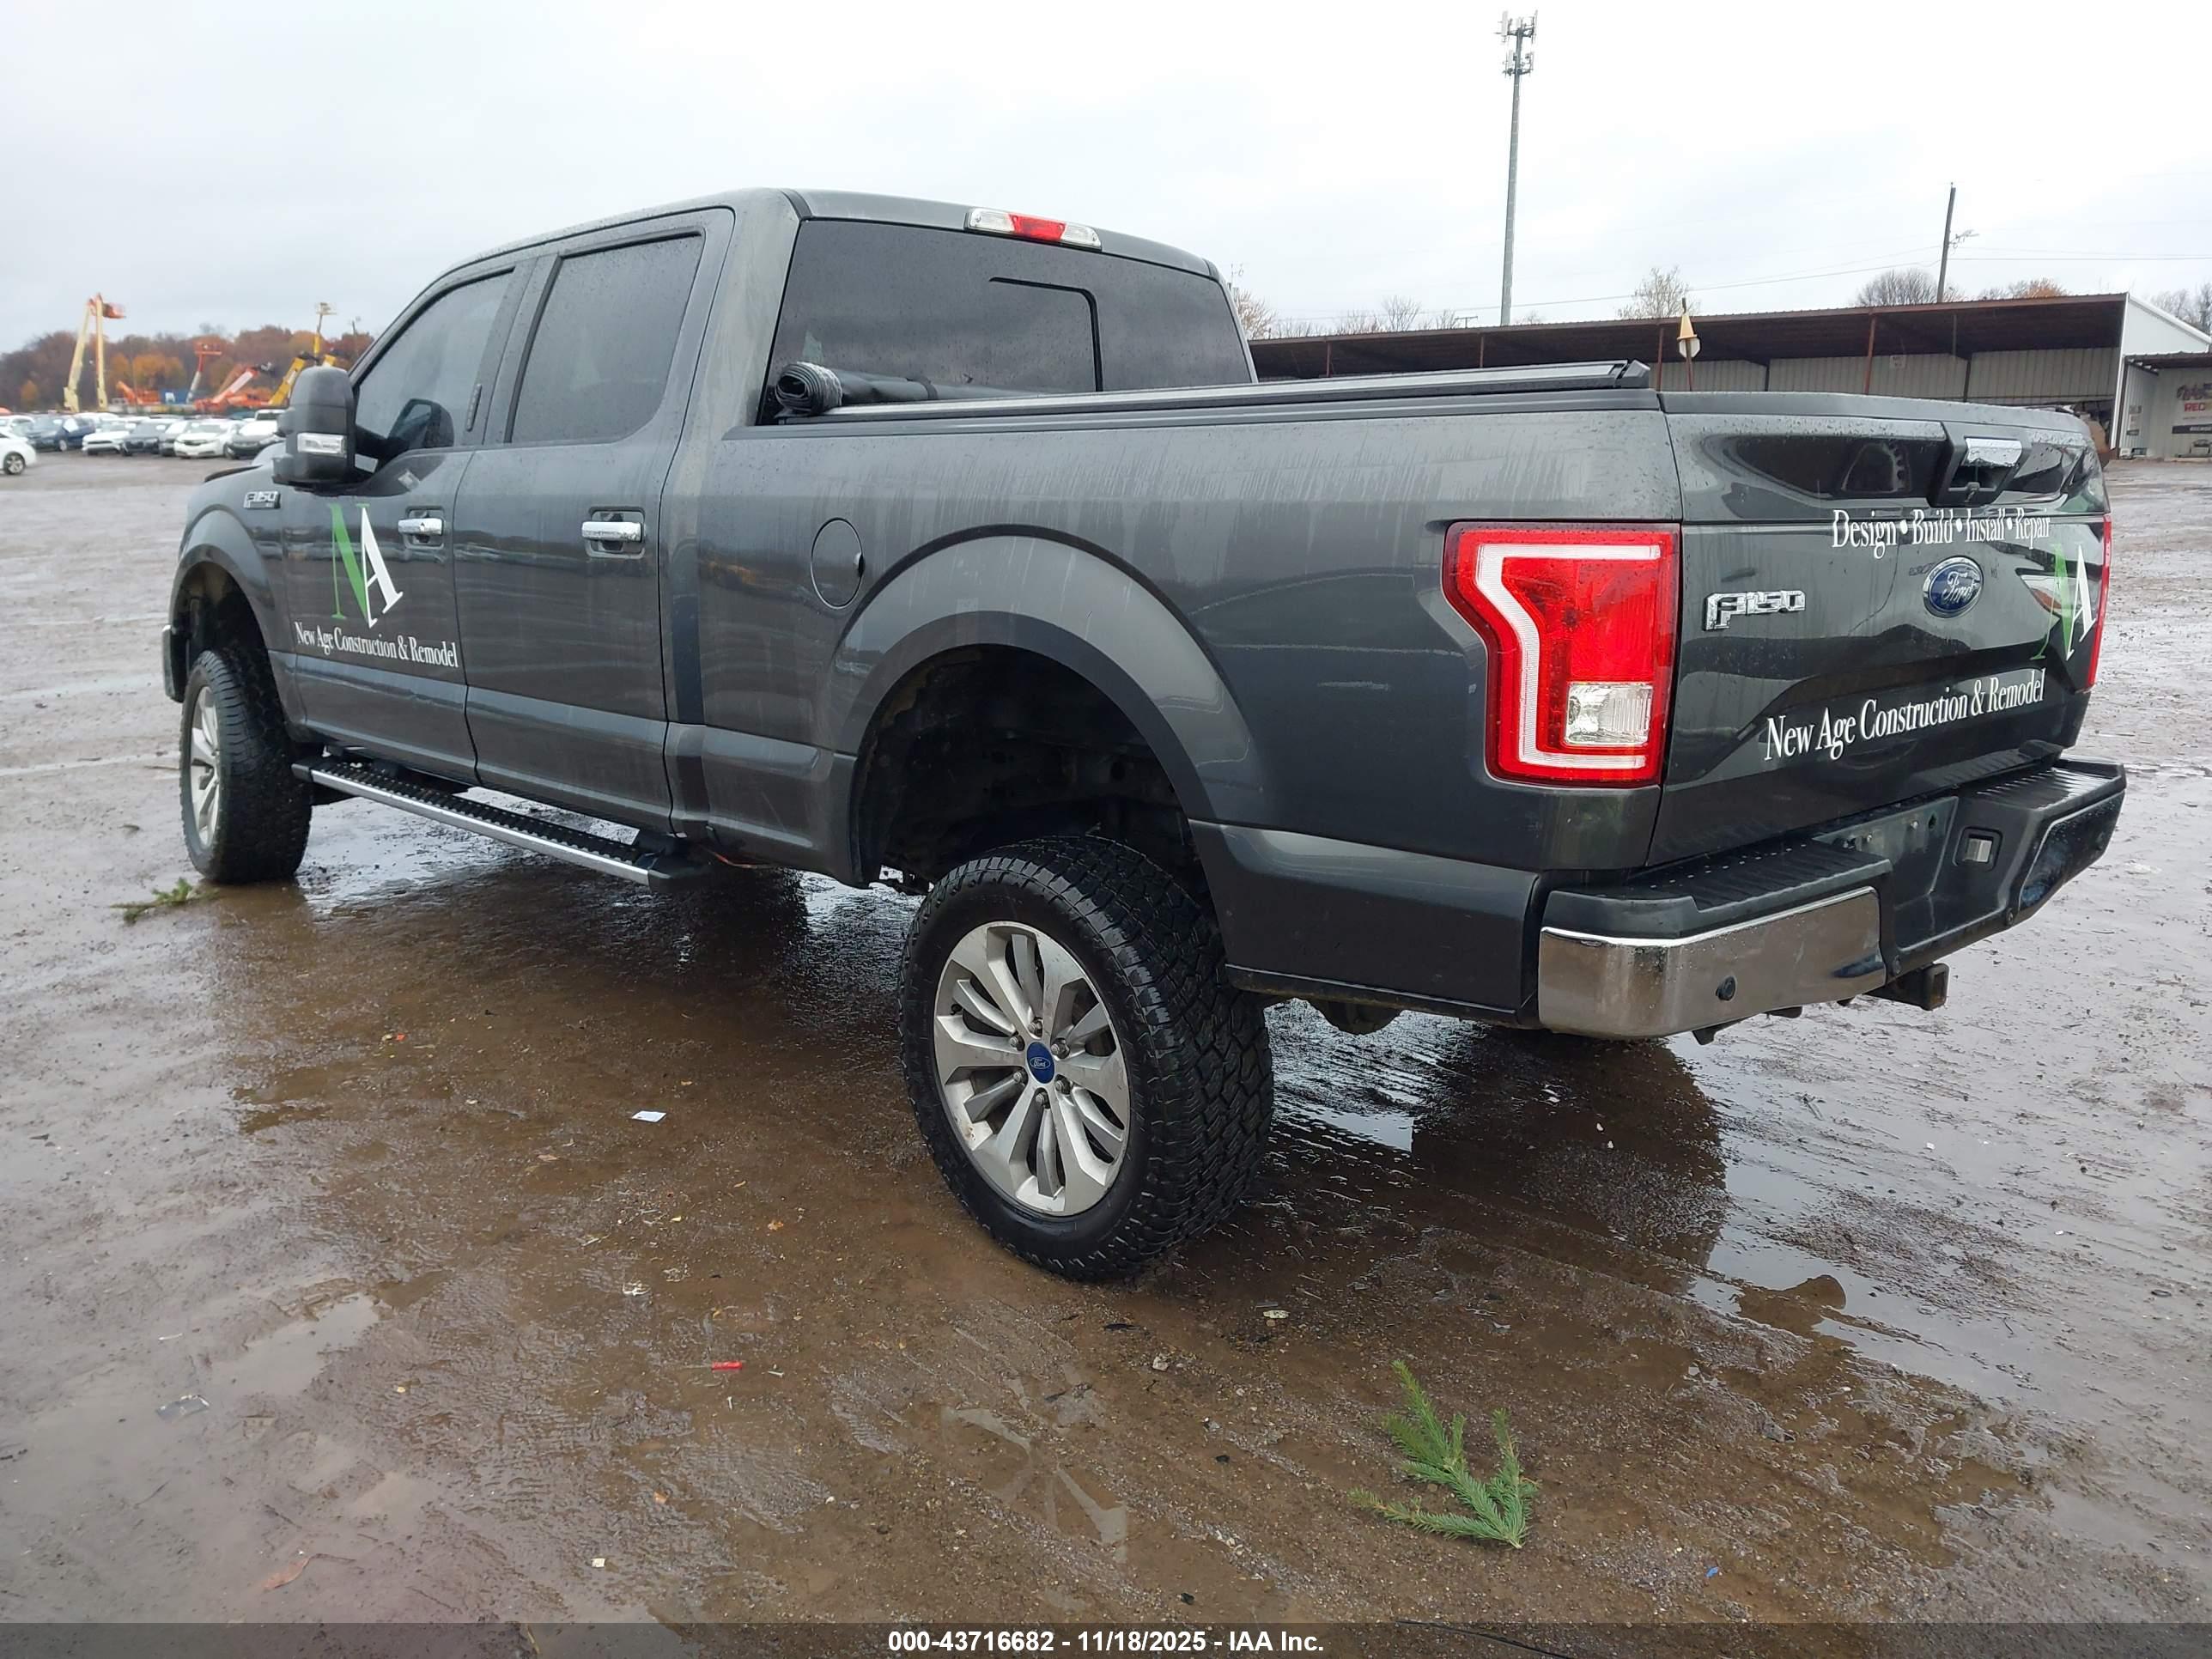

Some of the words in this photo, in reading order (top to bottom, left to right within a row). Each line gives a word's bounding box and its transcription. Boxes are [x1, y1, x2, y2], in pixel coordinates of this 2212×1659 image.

[1832, 509, 1897, 559] Design
[1912, 508, 1953, 544] Build
[1966, 508, 2005, 542] Install
[2014, 507, 2051, 550] Repair
[294, 621, 315, 646] New
[316, 624, 334, 655] Age
[334, 627, 398, 659] Construction
[398, 635, 410, 660] &
[408, 636, 459, 667] Remodel
[1764, 714, 1815, 761] New
[1815, 707, 1856, 760] Age
[1860, 686, 1967, 740] Construction
[1971, 679, 1986, 717] &
[1986, 667, 2046, 714] Remodel
